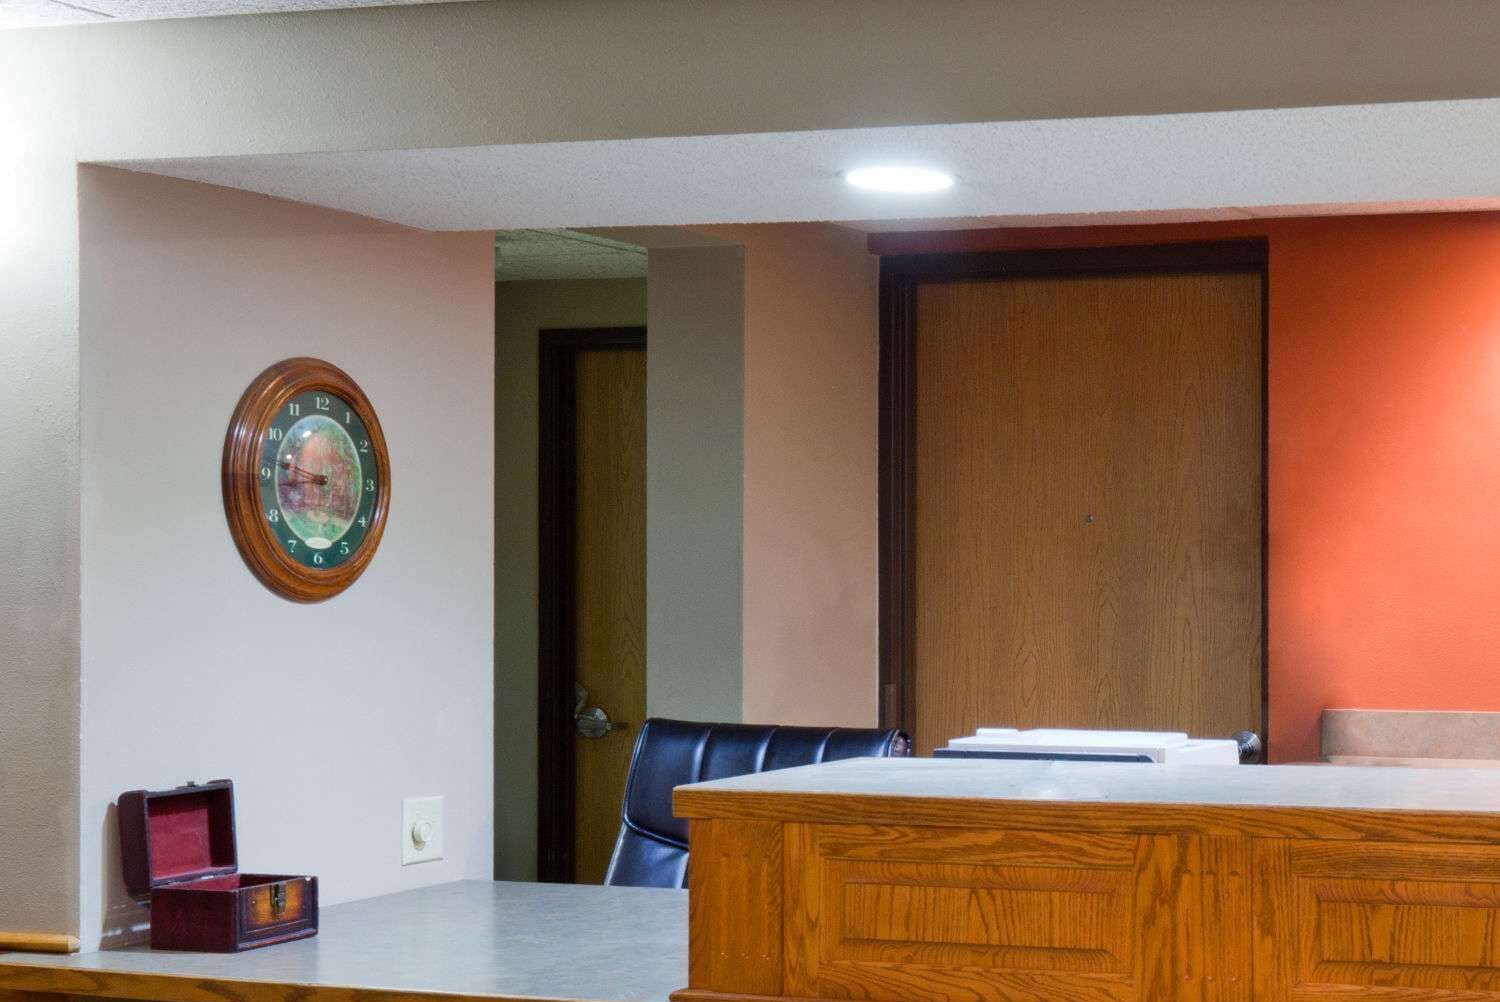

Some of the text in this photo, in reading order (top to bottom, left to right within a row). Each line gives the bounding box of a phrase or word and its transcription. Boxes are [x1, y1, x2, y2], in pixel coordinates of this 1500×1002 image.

[288, 403, 300, 416] 11
[315, 397, 329, 410] 12
[269, 428, 283, 441] 10
[360, 440, 368, 453] 2
[261, 468, 271, 480] 9
[366, 480, 375, 491] 3
[269, 509, 279, 522] 8
[288, 540, 297, 552] 7
[340, 542, 349, 554] 5
[314, 551, 323, 564] 6
